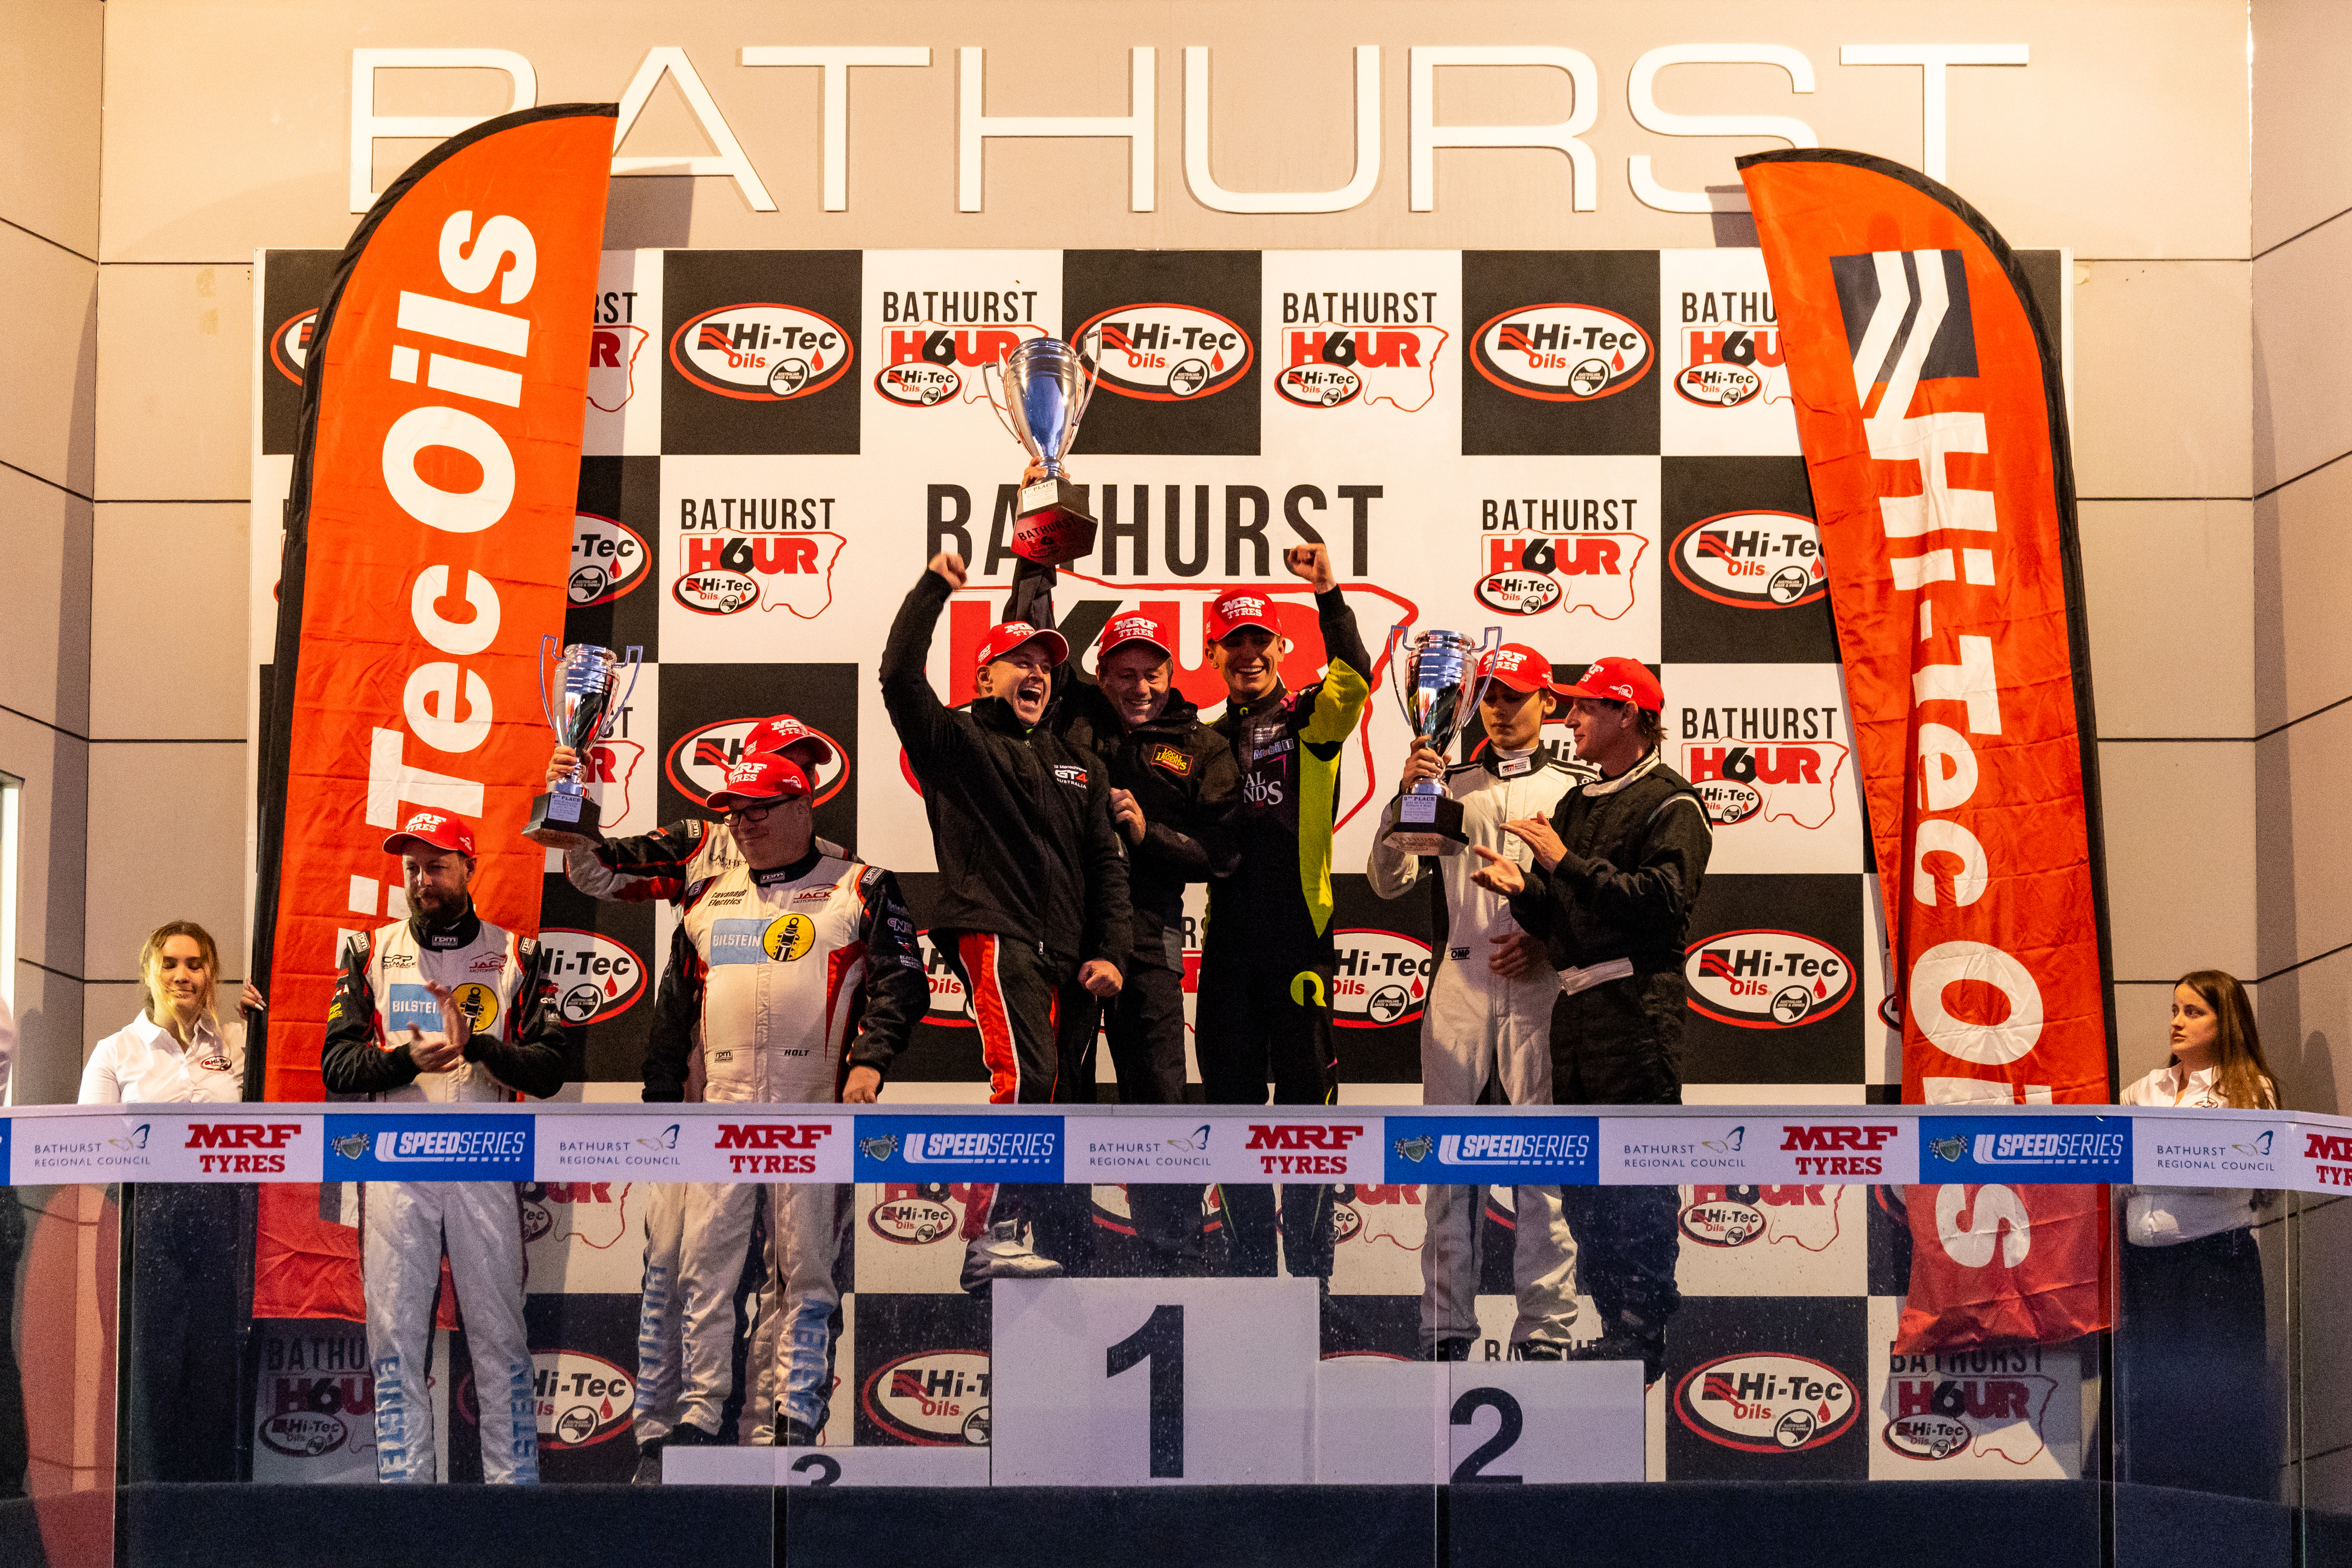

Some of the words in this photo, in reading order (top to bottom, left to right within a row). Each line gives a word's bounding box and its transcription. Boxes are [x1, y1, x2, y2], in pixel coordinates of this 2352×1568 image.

[350, 43, 2029, 213] BATHURST
[883, 291, 1037, 323] BATHURST
[1283, 292, 1437, 324] BATHURST
[1682, 292, 1777, 323] BATHU
[731, 323, 837, 350] Hi-Tec
[1132, 323, 1237, 350] Hi-Tec
[1533, 323, 1637, 350] Hi-Tec
[727, 353, 766, 368] Oils
[1128, 351, 1166, 368] Oils
[1529, 353, 1566, 369] Oils
[382, 210, 537, 533] Oils
[904, 370, 954, 383] Hi-Tec
[1304, 371, 1355, 385] Hi-Tec
[1703, 370, 1754, 384] Hi-Tec
[902, 384, 920, 392] Oils
[1701, 384, 1720, 393] Oils
[681, 498, 836, 530] BATHURST
[1482, 499, 1637, 531] BATHURST
[1727, 561, 1765, 576] Oils
[702, 578, 753, 591] Hi-Tec
[1504, 579, 1555, 592] Hi-Tec
[699, 592, 718, 600] Oils
[1502, 593, 1520, 601] Oils
[1221, 596, 1265, 613] MRF
[1227, 608, 1263, 620] TYRES
[1113, 617, 1158, 631] MRF
[1118, 628, 1154, 638] TYRES
[1682, 707, 1837, 740] BATHURST
[1155, 752, 1187, 771] LEGENDS
[1164, 748, 1183, 762] LOCAL
[1054, 769, 1089, 783] GT4
[1704, 787, 1755, 801] Hi-Tec
[707, 898, 742, 907] Electrics
[794, 891, 833, 900] JACK
[713, 934, 762, 947] BILSTEIN
[1450, 948, 1470, 959] OMP
[1733, 949, 1839, 977] Hi-Tec
[1730, 979, 1768, 996] Oils
[185, 1124, 302, 1149] MRF
[714, 1124, 832, 1149] MRF
[1245, 1125, 1364, 1150] MRF
[1780, 1125, 1898, 1151] MRF
[34, 1142, 101, 1154] BATHURST
[560, 1141, 631, 1152] BATHURST
[1089, 1142, 1160, 1153] BATHURST
[1624, 1144, 1695, 1155] BATHURST
[2157, 1145, 2226, 1157] BATHURST
[34, 1157, 92, 1167] REGIONAL
[97, 1156, 151, 1166] COUNCIL
[199, 1154, 286, 1173] TYRES
[560, 1155, 620, 1165] REGIONAL
[626, 1155, 680, 1165] COUNCIL
[729, 1154, 816, 1174] TYRES
[1089, 1157, 1150, 1166] REGIONAL
[1156, 1157, 1211, 1166] COUNCIL
[1260, 1155, 1348, 1174] TYRES
[1624, 1159, 1685, 1168] REGIONAL
[1691, 1159, 1746, 1168] COUNCIL
[1795, 1156, 1883, 1176] TYRES
[2157, 1159, 2216, 1170] REGIONAL
[2221, 1160, 2275, 1172] COUNCIL
[898, 1206, 950, 1222] Hi-Tec
[1708, 1209, 1758, 1225] Hi-Tec
[1106, 1304, 1184, 1479] 1
[1737, 1373, 1844, 1401] Hi-Tec
[922, 1400, 959, 1417] Oils
[1733, 1403, 1772, 1420] Oils
[1450, 1387, 1524, 1485] 2
[1912, 1422, 1964, 1436] Hi-Tec
